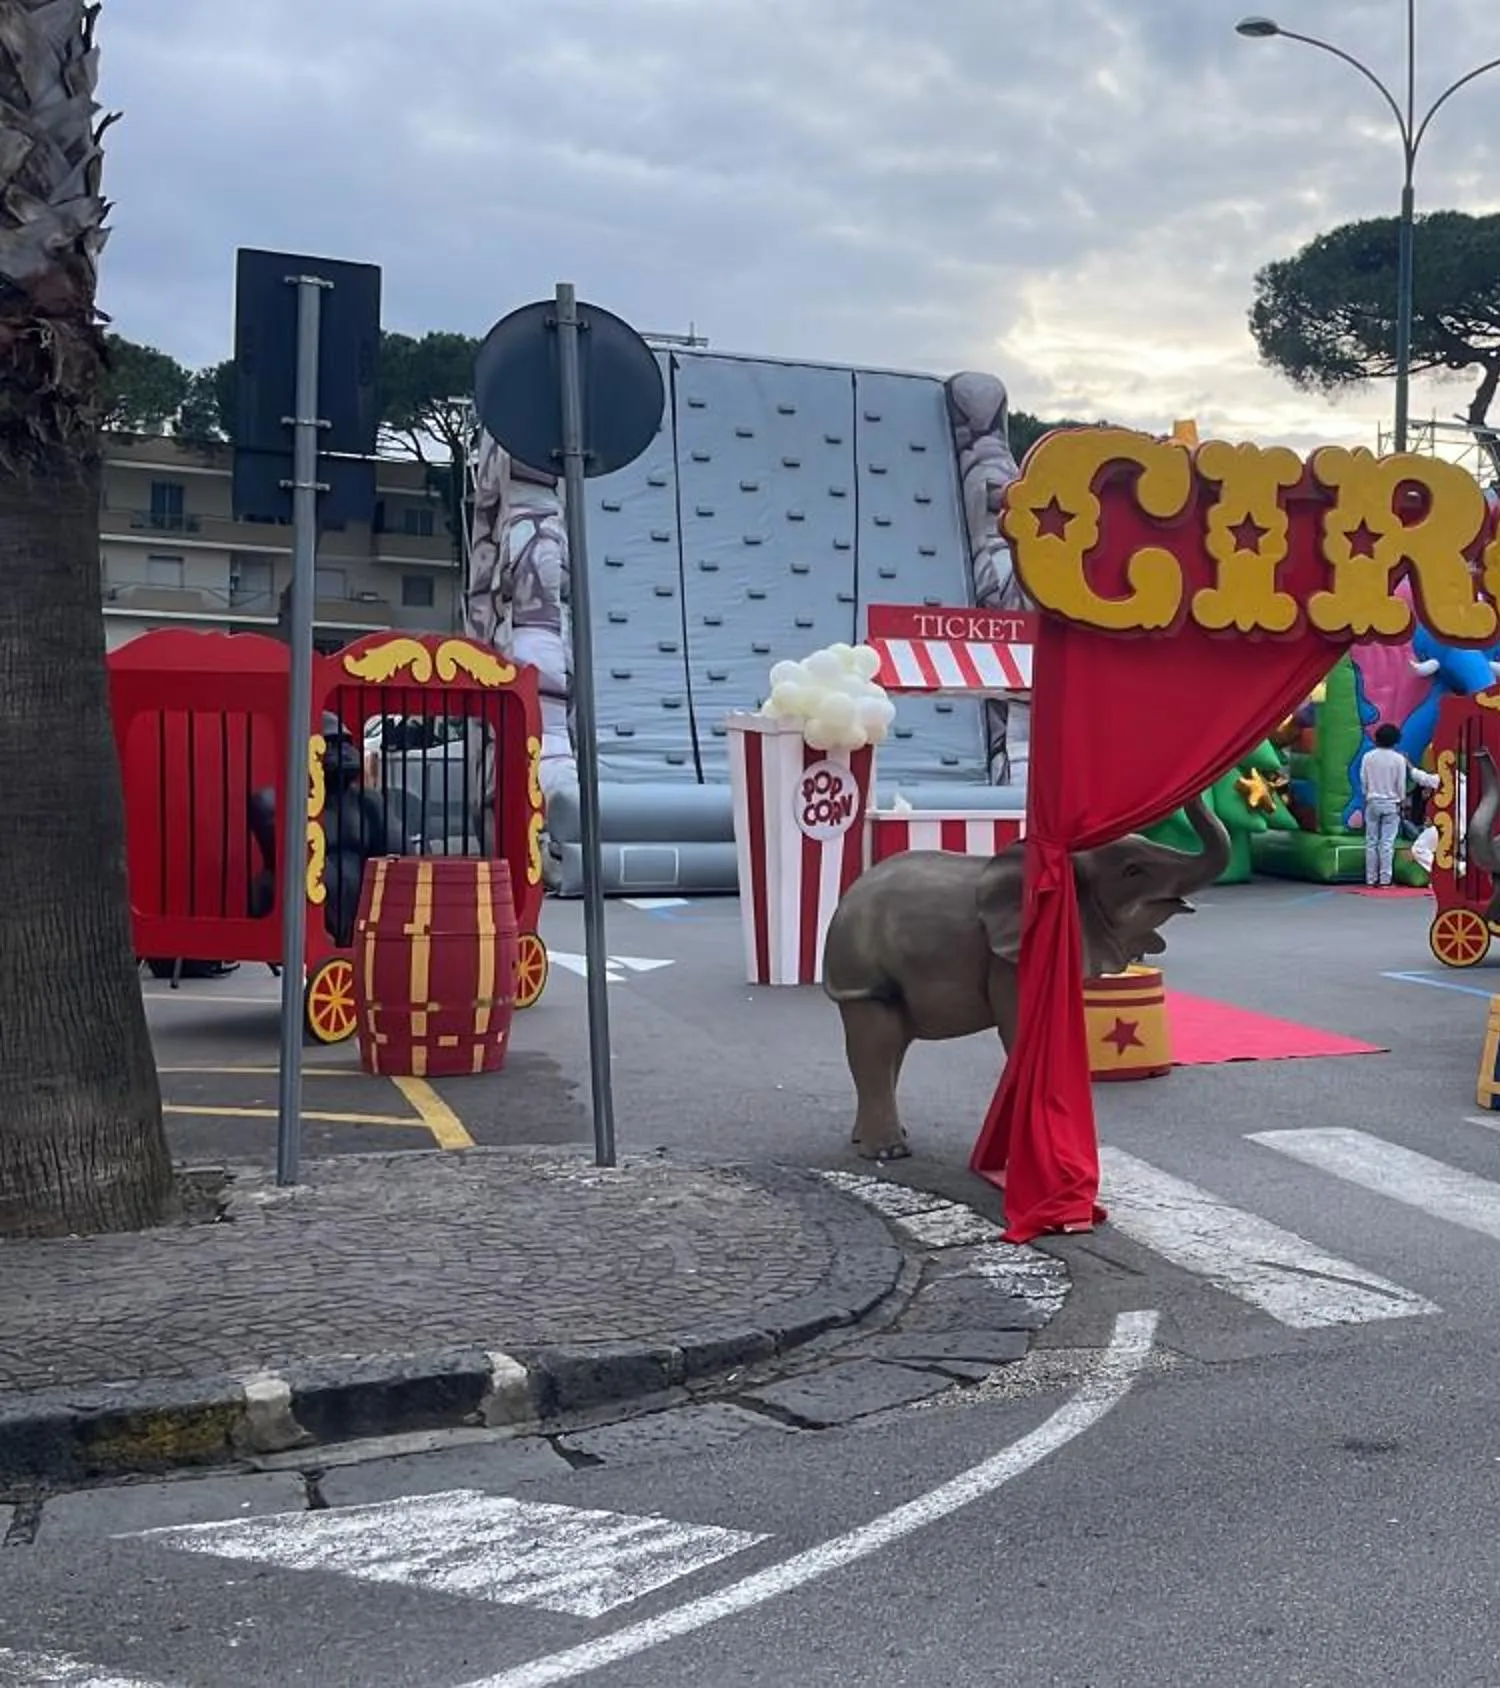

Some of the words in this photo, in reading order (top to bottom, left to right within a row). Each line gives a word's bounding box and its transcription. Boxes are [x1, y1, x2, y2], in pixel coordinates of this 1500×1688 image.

[913, 614, 1025, 641] TICKET
[802, 770, 843, 802] POP
[802, 793, 853, 827] CORN
